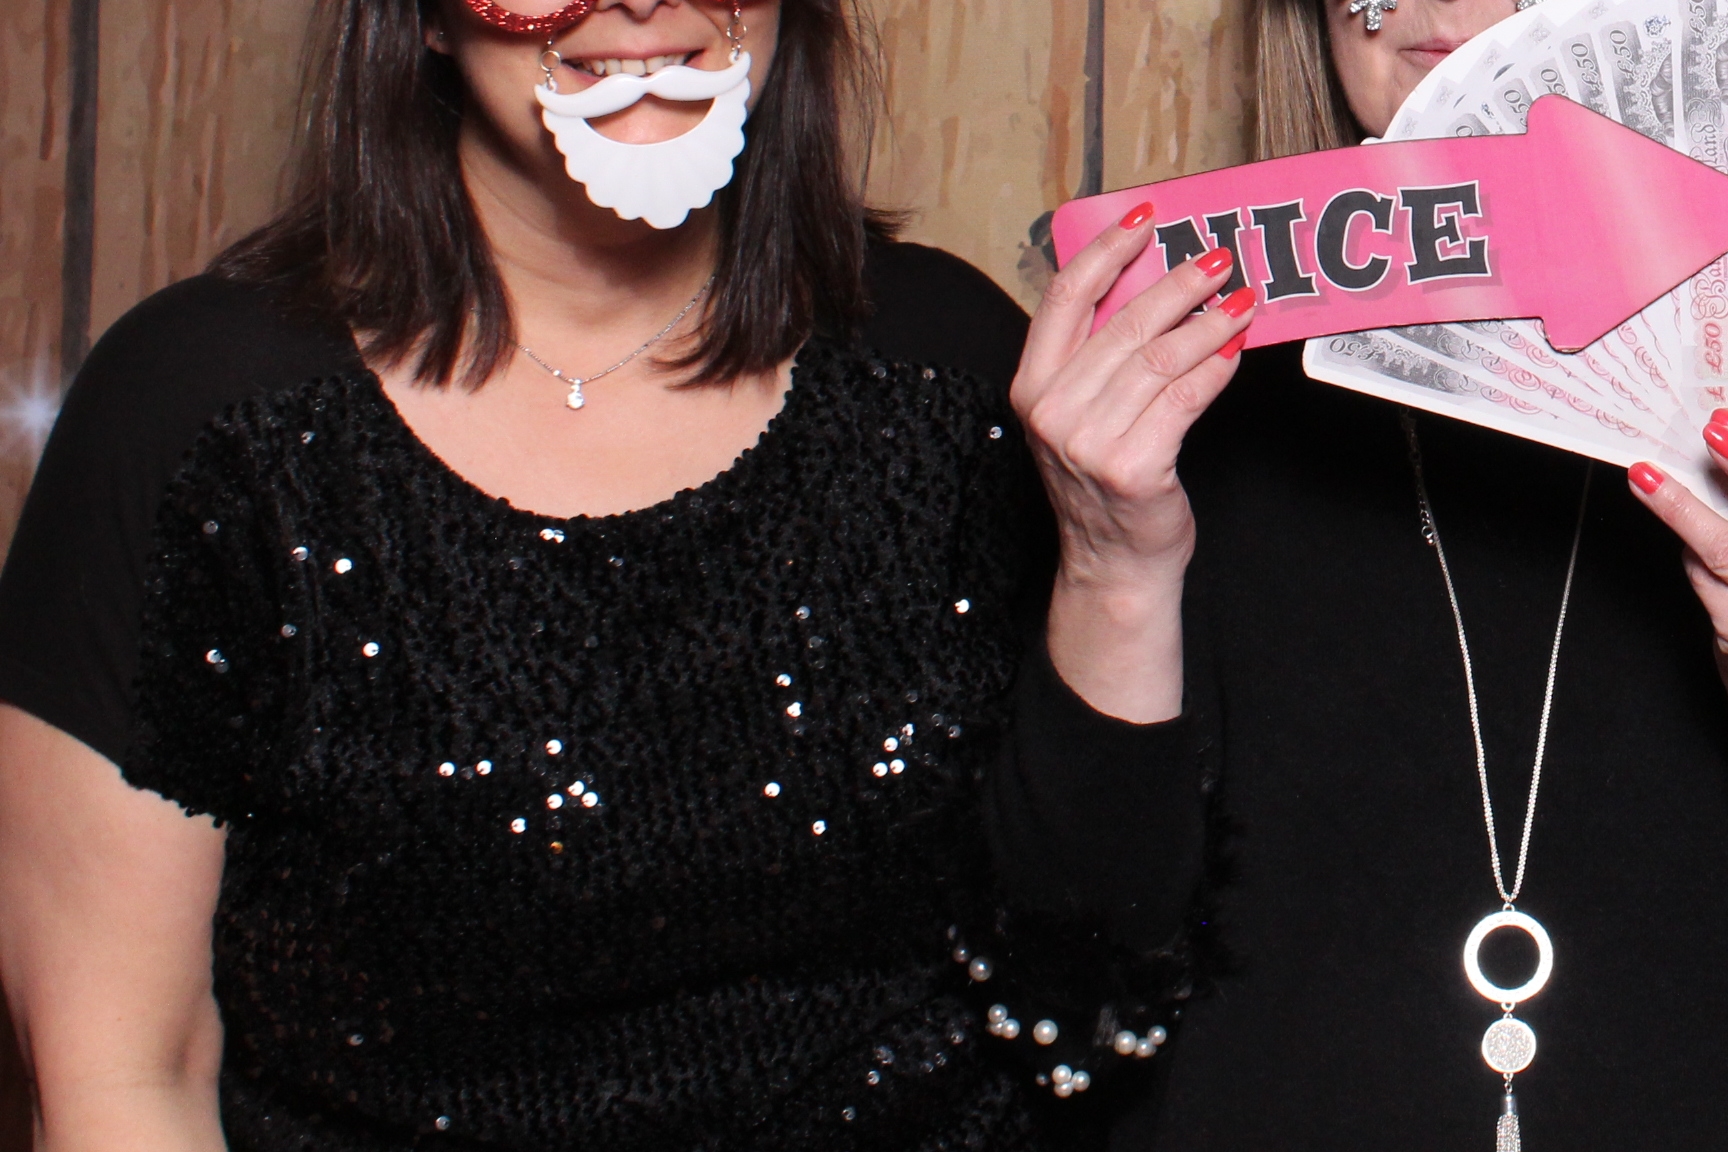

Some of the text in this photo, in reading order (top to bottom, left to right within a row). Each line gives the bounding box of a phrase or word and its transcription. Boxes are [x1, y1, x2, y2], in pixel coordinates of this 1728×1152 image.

[1570, 43, 1602, 87] £50
[1610, 30, 1636, 79] £50
[1540, 68, 1568, 94] 50
[1154, 180, 1492, 314] NICE
[1329, 337, 1379, 361] £50
[1704, 323, 1723, 374] £50
